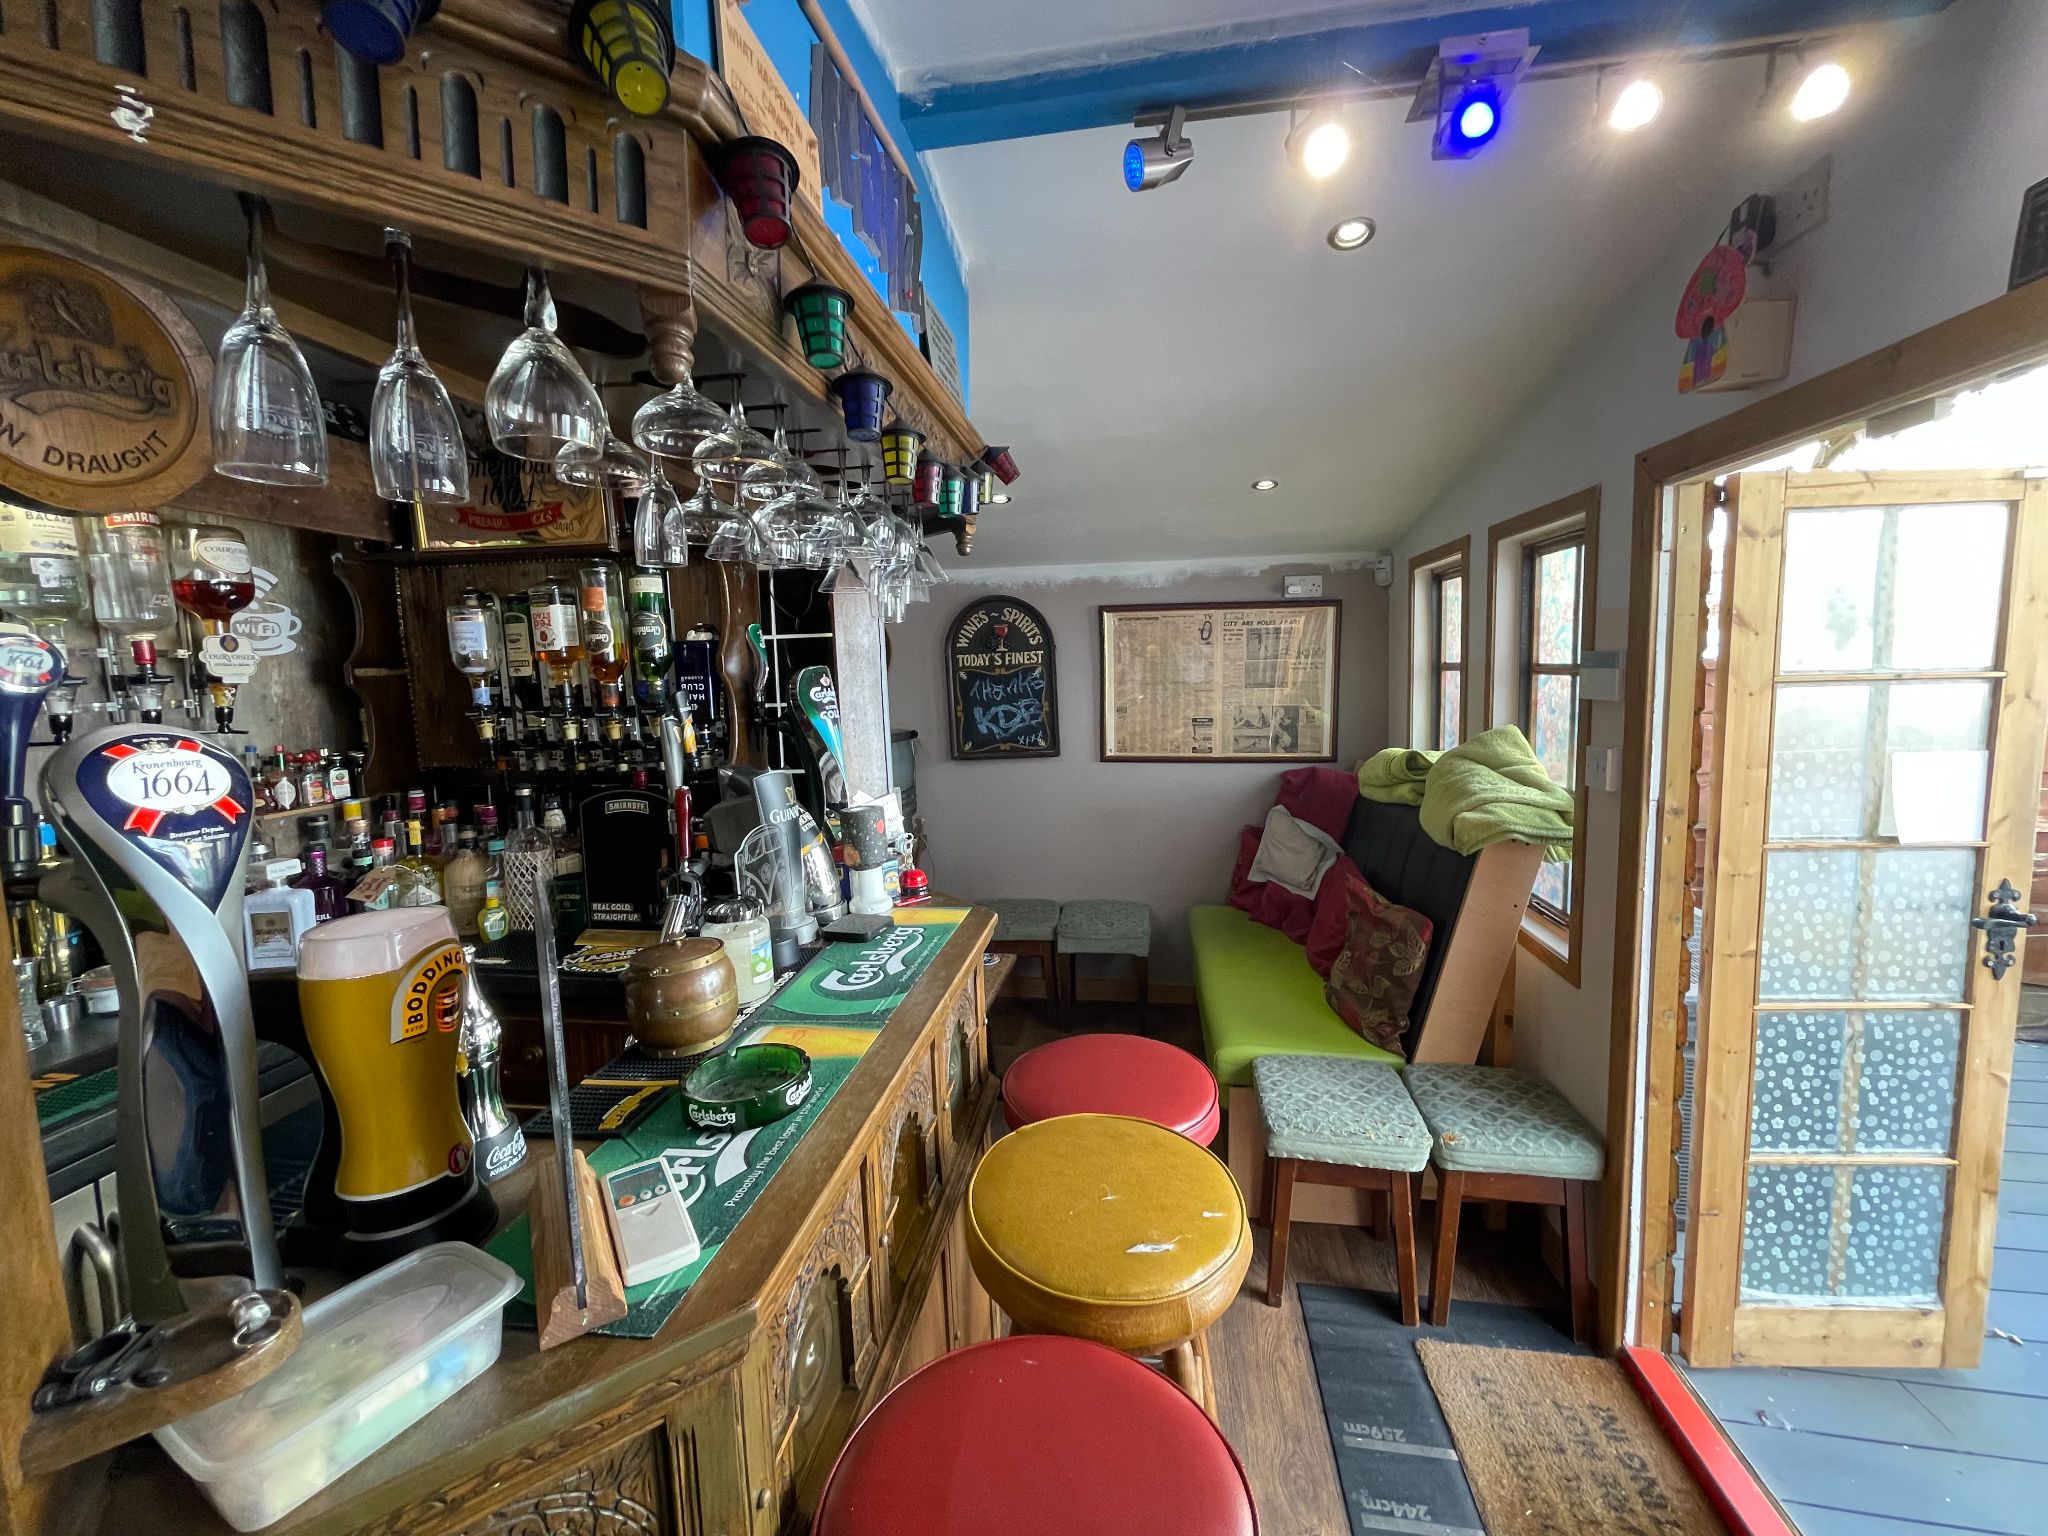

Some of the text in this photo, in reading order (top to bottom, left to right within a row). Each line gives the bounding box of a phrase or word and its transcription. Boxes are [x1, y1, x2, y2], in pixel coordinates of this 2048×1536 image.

[43, 430, 168, 474] DRAUGHT
[956, 606, 1043, 648] WINES SPIRITS
[6, 654, 45, 670] 1664
[956, 650, 1044, 667] TODAY'S FINEST
[689, 693, 705, 701] HAI
[820, 709, 840, 720] COL
[132, 757, 203, 775] Kronenbourg
[138, 767, 216, 800] 1664
[592, 902, 632, 911] REAL GOLD.
[593, 912, 640, 921] STRAIGHT UP.
[819, 926, 925, 991] Carlsberg
[688, 1103, 737, 1127] Carlsberg
[724, 1170, 764, 1207] Probably
[756, 1153, 773, 1169] the
[765, 1142, 785, 1156] best
[778, 1122, 799, 1141] lager
[793, 1114, 804, 1125] in
[799, 1102, 813, 1118] the
[1343, 1421, 1407, 1443] 259cm
[1360, 1495, 1432, 1522] 244cm
